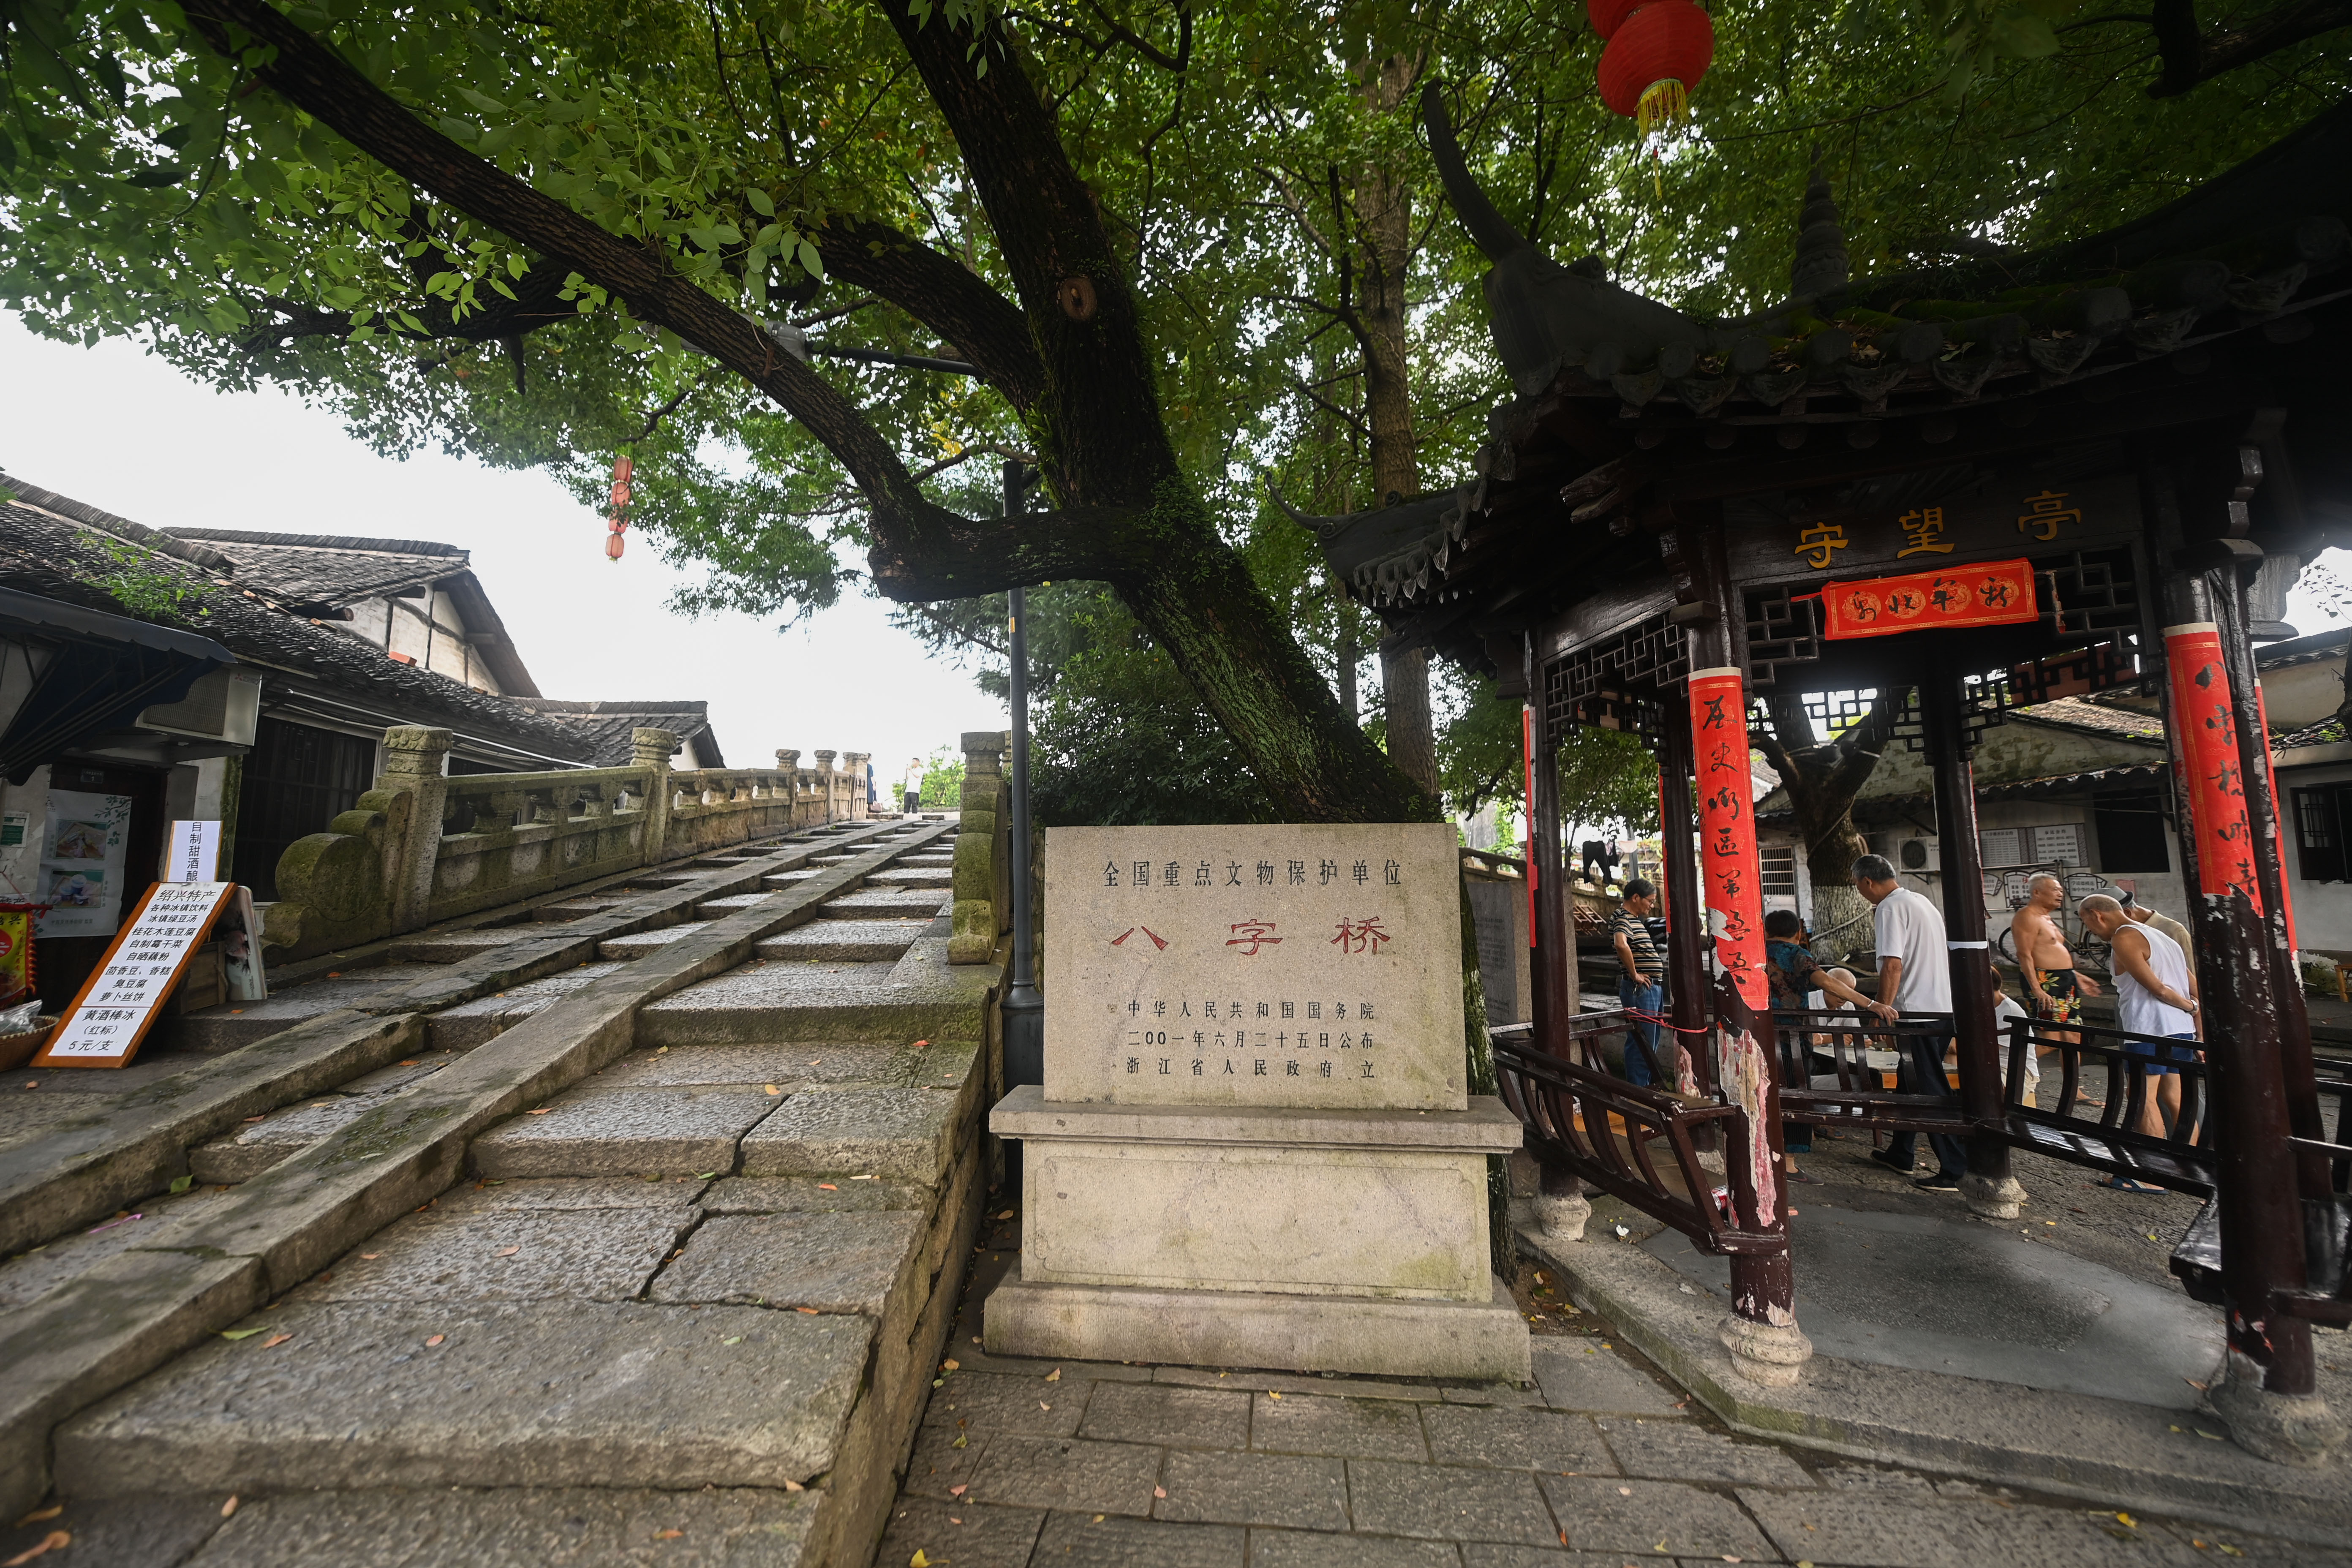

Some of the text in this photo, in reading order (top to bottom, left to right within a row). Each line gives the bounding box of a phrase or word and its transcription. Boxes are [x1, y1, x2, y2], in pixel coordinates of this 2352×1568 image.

[1794, 490, 2081, 569] 守望亭
[186, 822, 202, 882] 自制甜酒酿
[1103, 859, 1401, 887] 全国重点文物保护单位
[157, 890, 216, 902] 绍兴特产
[150, 904, 209, 912] 各种冰镇饮料
[147, 915, 199, 923] 冰镇绿豆汤
[132, 927, 197, 936] 桂花木莲豆腐
[1111, 916, 1391, 956] 八字桥
[129, 939, 185, 949] 自制霉干菜
[126, 952, 170, 961] 自晒藕粉
[112, 979, 149, 988] 臭豆腐
[98, 992, 145, 1002] 萝卜丝饼
[82, 1009, 136, 1021] 黄酒棒冰
[1127, 1000, 1374, 1020] 中华人民共和国国务院
[1127, 1057, 1375, 1079] 浙江省人民政府立
